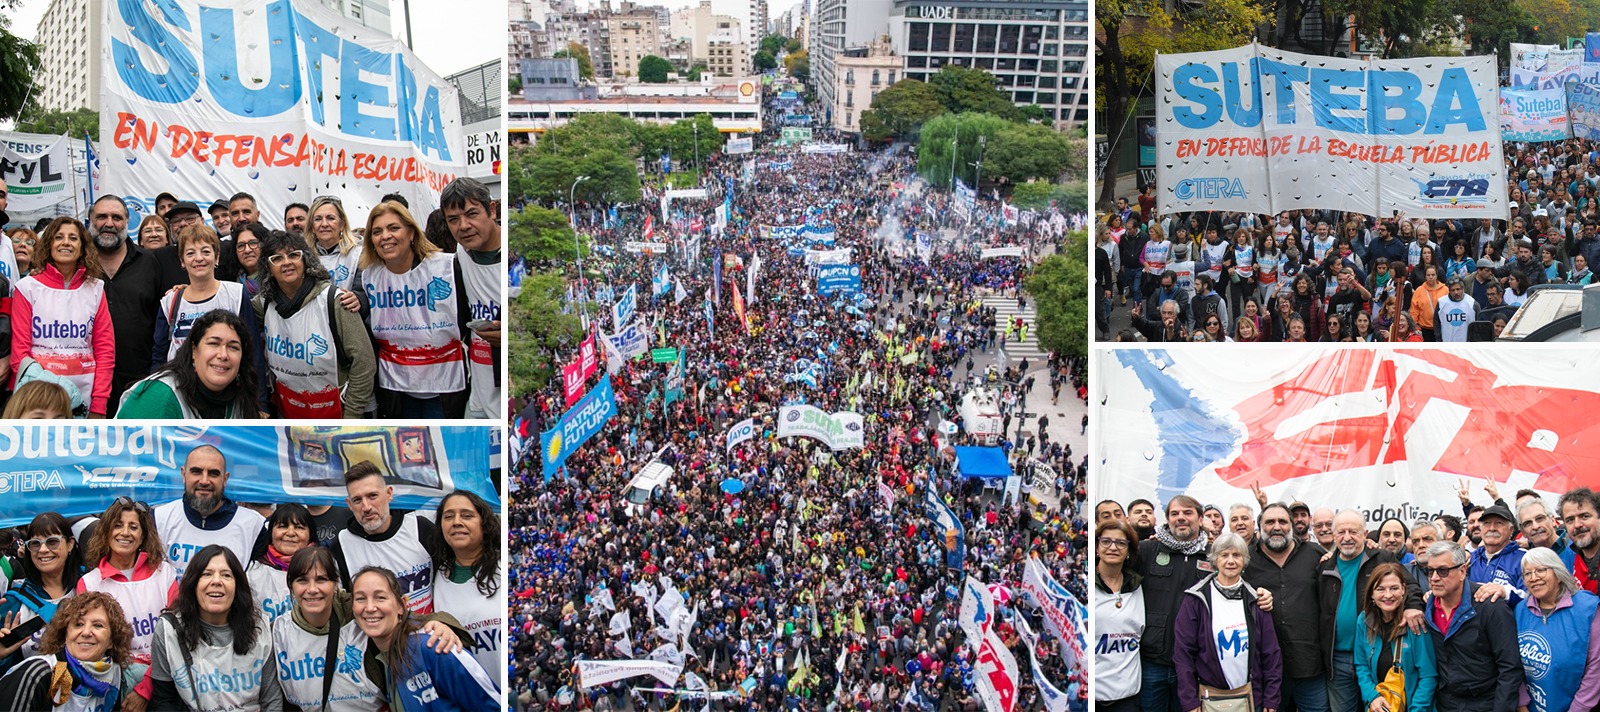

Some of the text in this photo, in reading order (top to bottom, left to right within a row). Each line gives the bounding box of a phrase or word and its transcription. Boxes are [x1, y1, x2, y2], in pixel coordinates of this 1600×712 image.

[920, 6, 951, 19] UADE
[111, 0, 453, 162] SUTEBA
[1172, 57, 1488, 135] SUTEBA
[1517, 96, 1560, 112] Suteba
[114, 112, 158, 152] EN
[164, 125, 310, 168] DEFENSA
[311, 139, 326, 173] DE
[328, 148, 349, 177] LA
[353, 152, 424, 184] ESCUELA
[467, 135, 479, 147] DE
[1176, 135, 1491, 164] EN DEFENSA DE LA ESCUELA PÚBLICA
[468, 149, 484, 165] RO
[1175, 178, 1247, 199] CTERA
[1424, 179, 1490, 197] CTA
[827, 267, 849, 276] UPCN
[366, 282, 426, 309] Suteba
[1206, 303, 1217, 313] M
[1446, 313, 1466, 322] UTE
[33, 316, 87, 339] Suteba
[564, 401, 601, 437] PATRIA
[601, 387, 608, 401] Y
[565, 401, 610, 450] FUTURO
[0, 470, 65, 493] CTERA
[90, 466, 160, 482] CTA
[1095, 634, 1139, 655] MAYO
